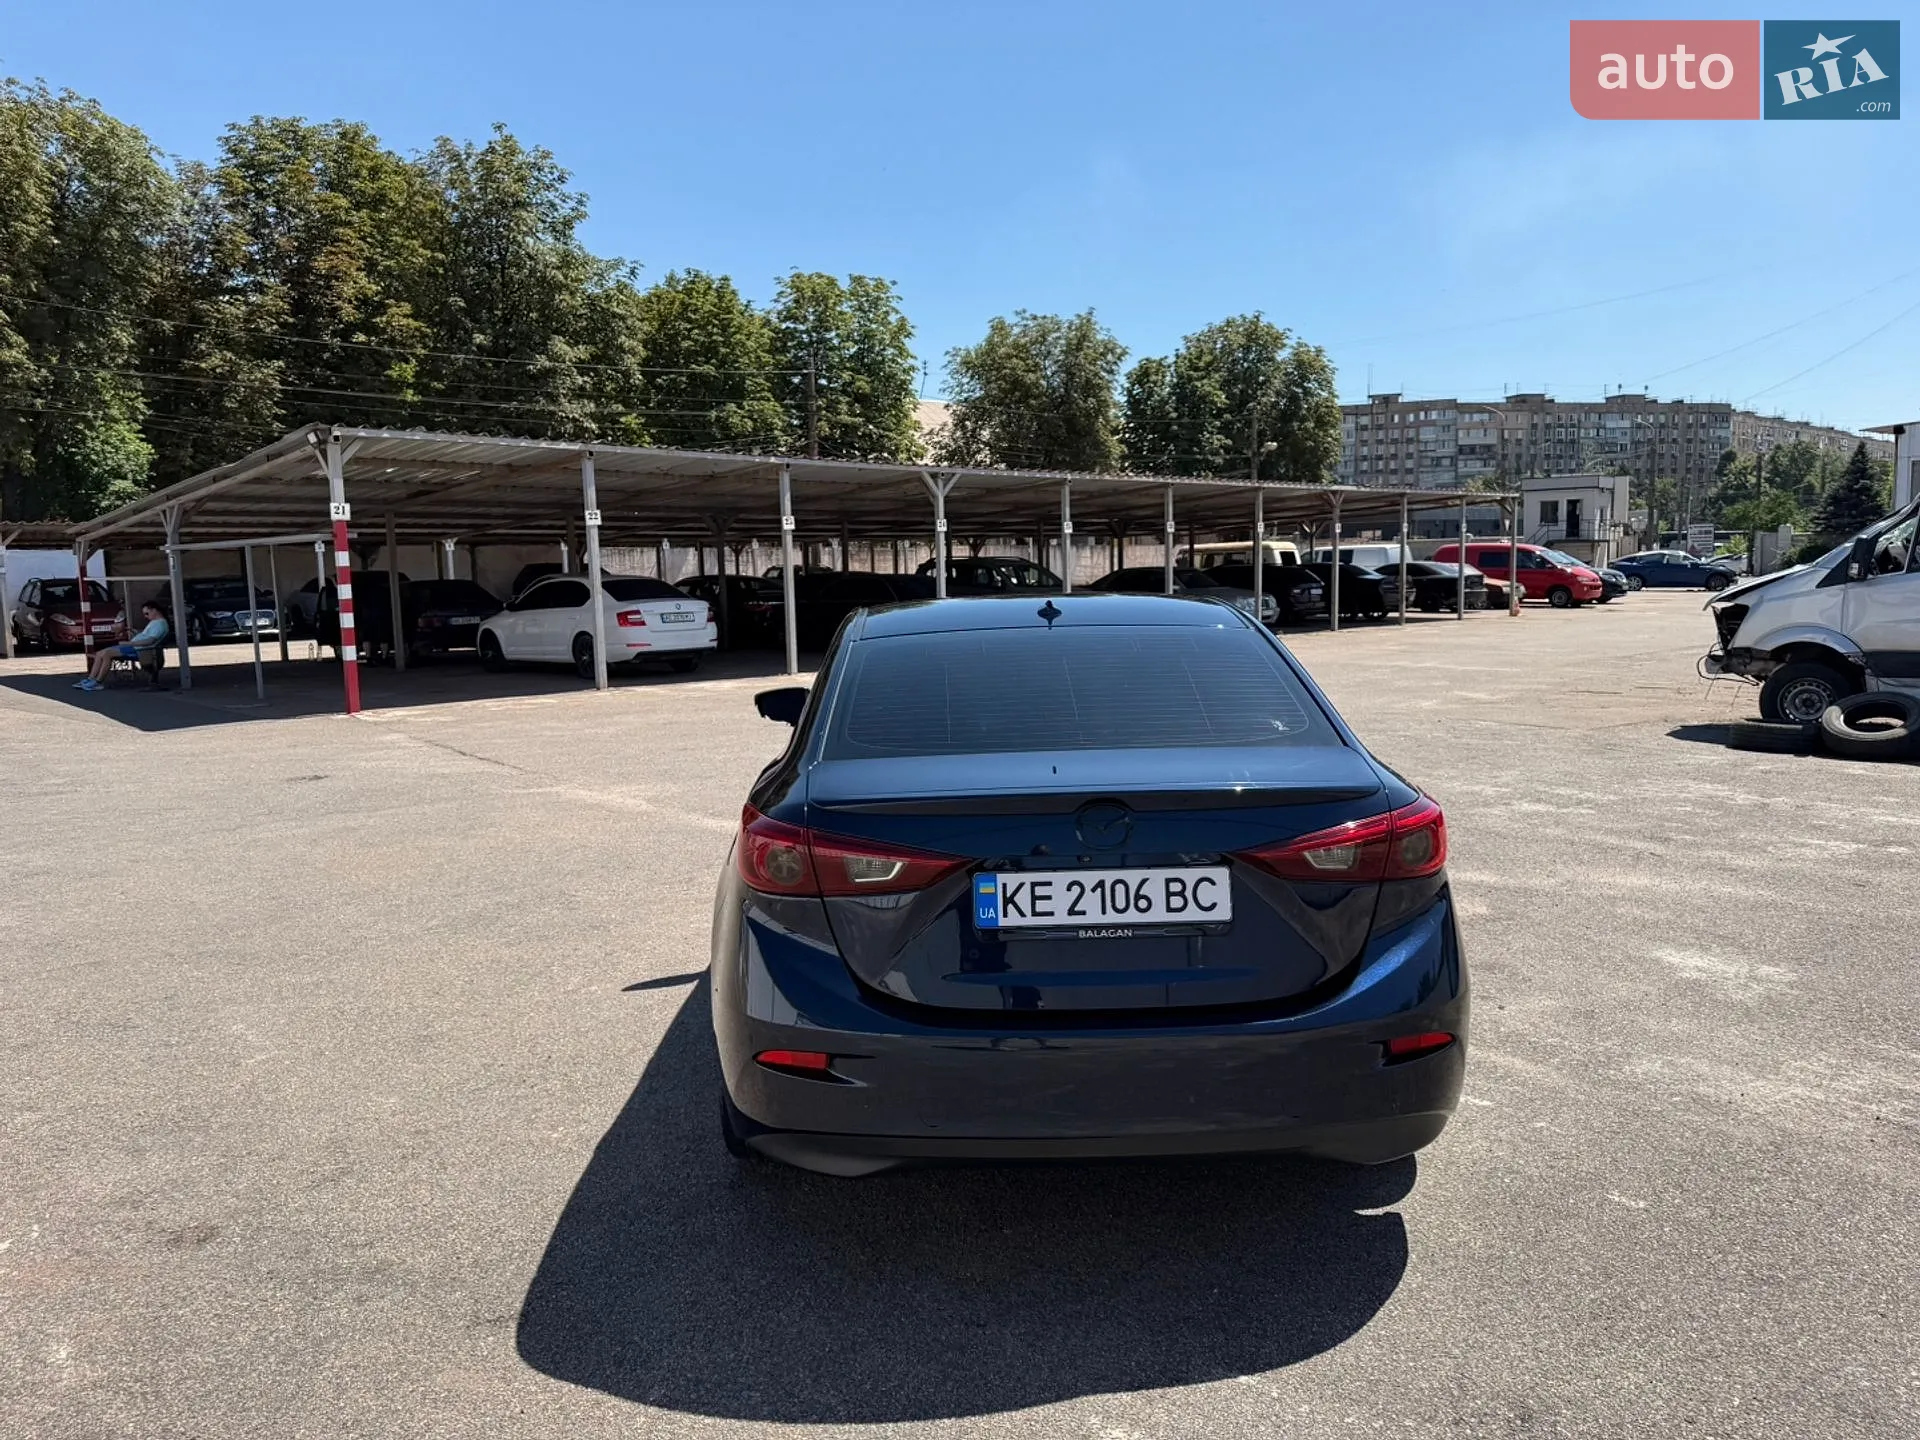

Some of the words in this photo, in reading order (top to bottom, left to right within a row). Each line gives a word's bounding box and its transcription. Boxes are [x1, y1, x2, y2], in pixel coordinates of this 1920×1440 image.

[333, 505, 346, 516] 21
[1001, 880, 1055, 919] KE
[1065, 877, 1153, 917] 2106
[1164, 876, 1218, 914] BC
[979, 907, 996, 919] UA
[1077, 928, 1133, 939] BALAGAN
